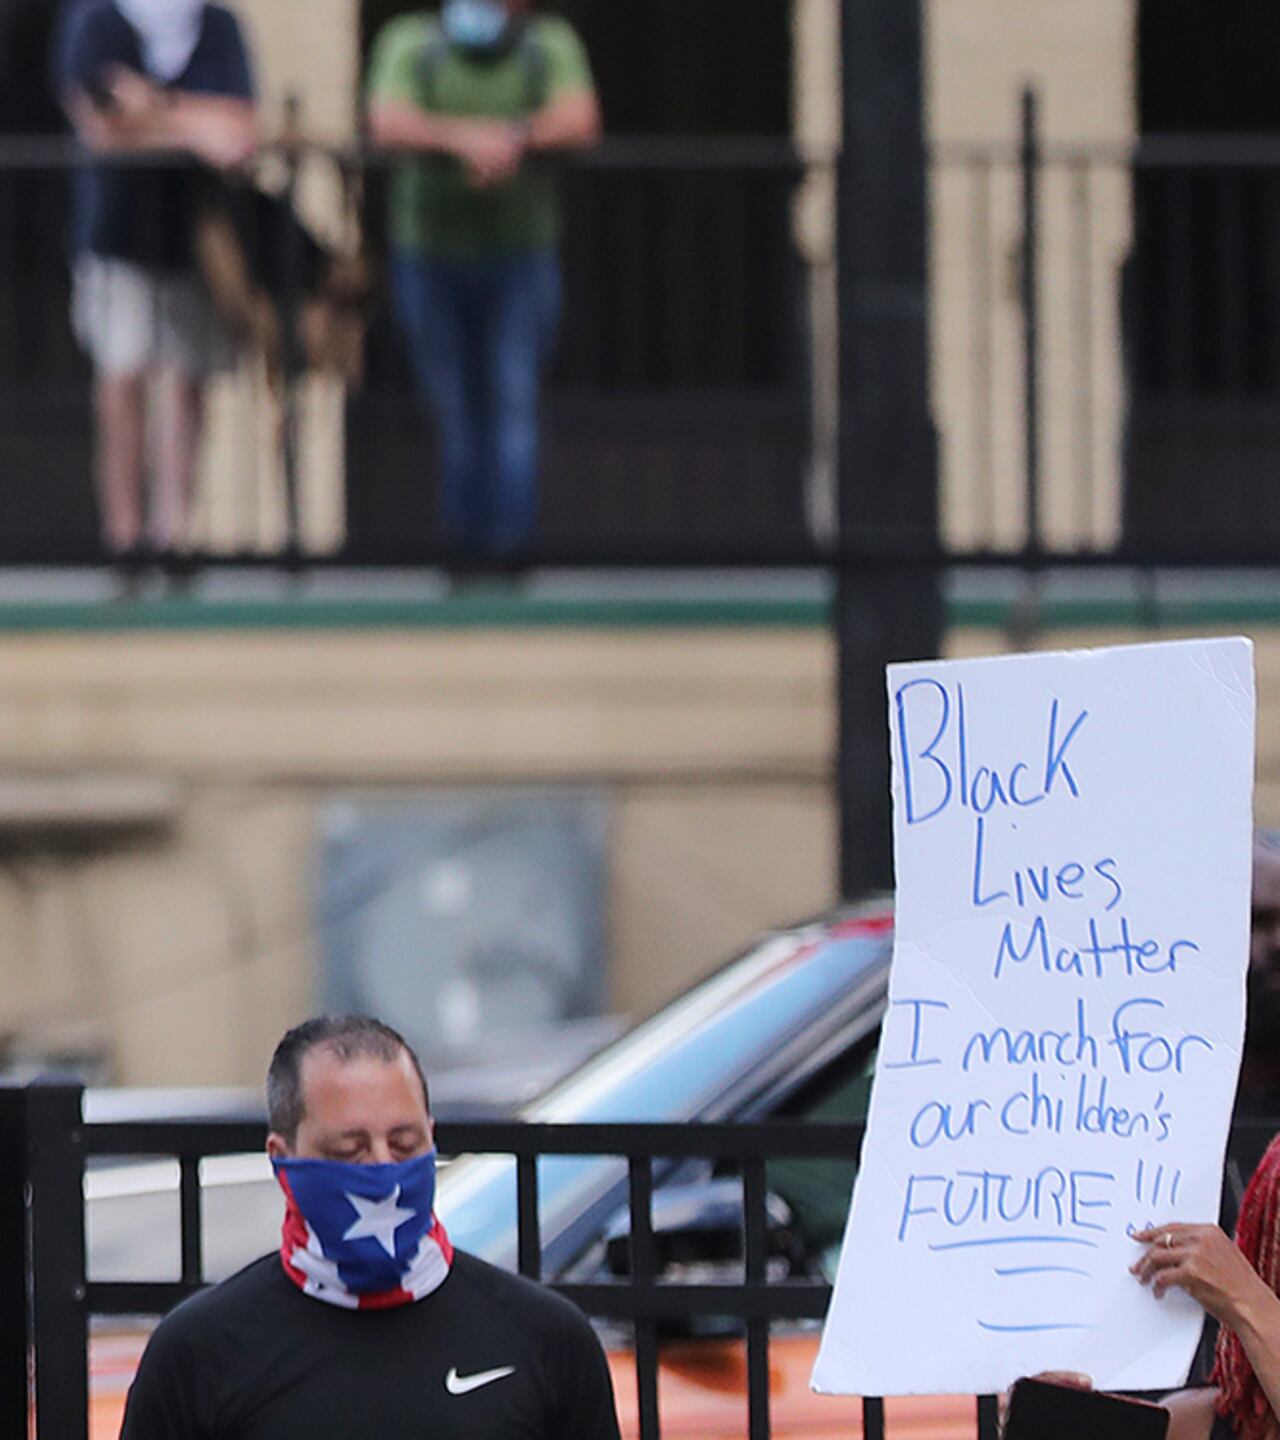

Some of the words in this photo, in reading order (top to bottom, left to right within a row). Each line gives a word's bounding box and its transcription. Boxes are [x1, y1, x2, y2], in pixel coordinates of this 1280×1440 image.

[896, 678, 1089, 824] Black
[973, 816, 1122, 911] Lives
[994, 915, 1199, 979] Matter
[885, 999, 950, 1069] I
[962, 997, 1097, 1072] march
[910, 1099, 991, 1148] our
[1000, 1071, 1172, 1142] children's
